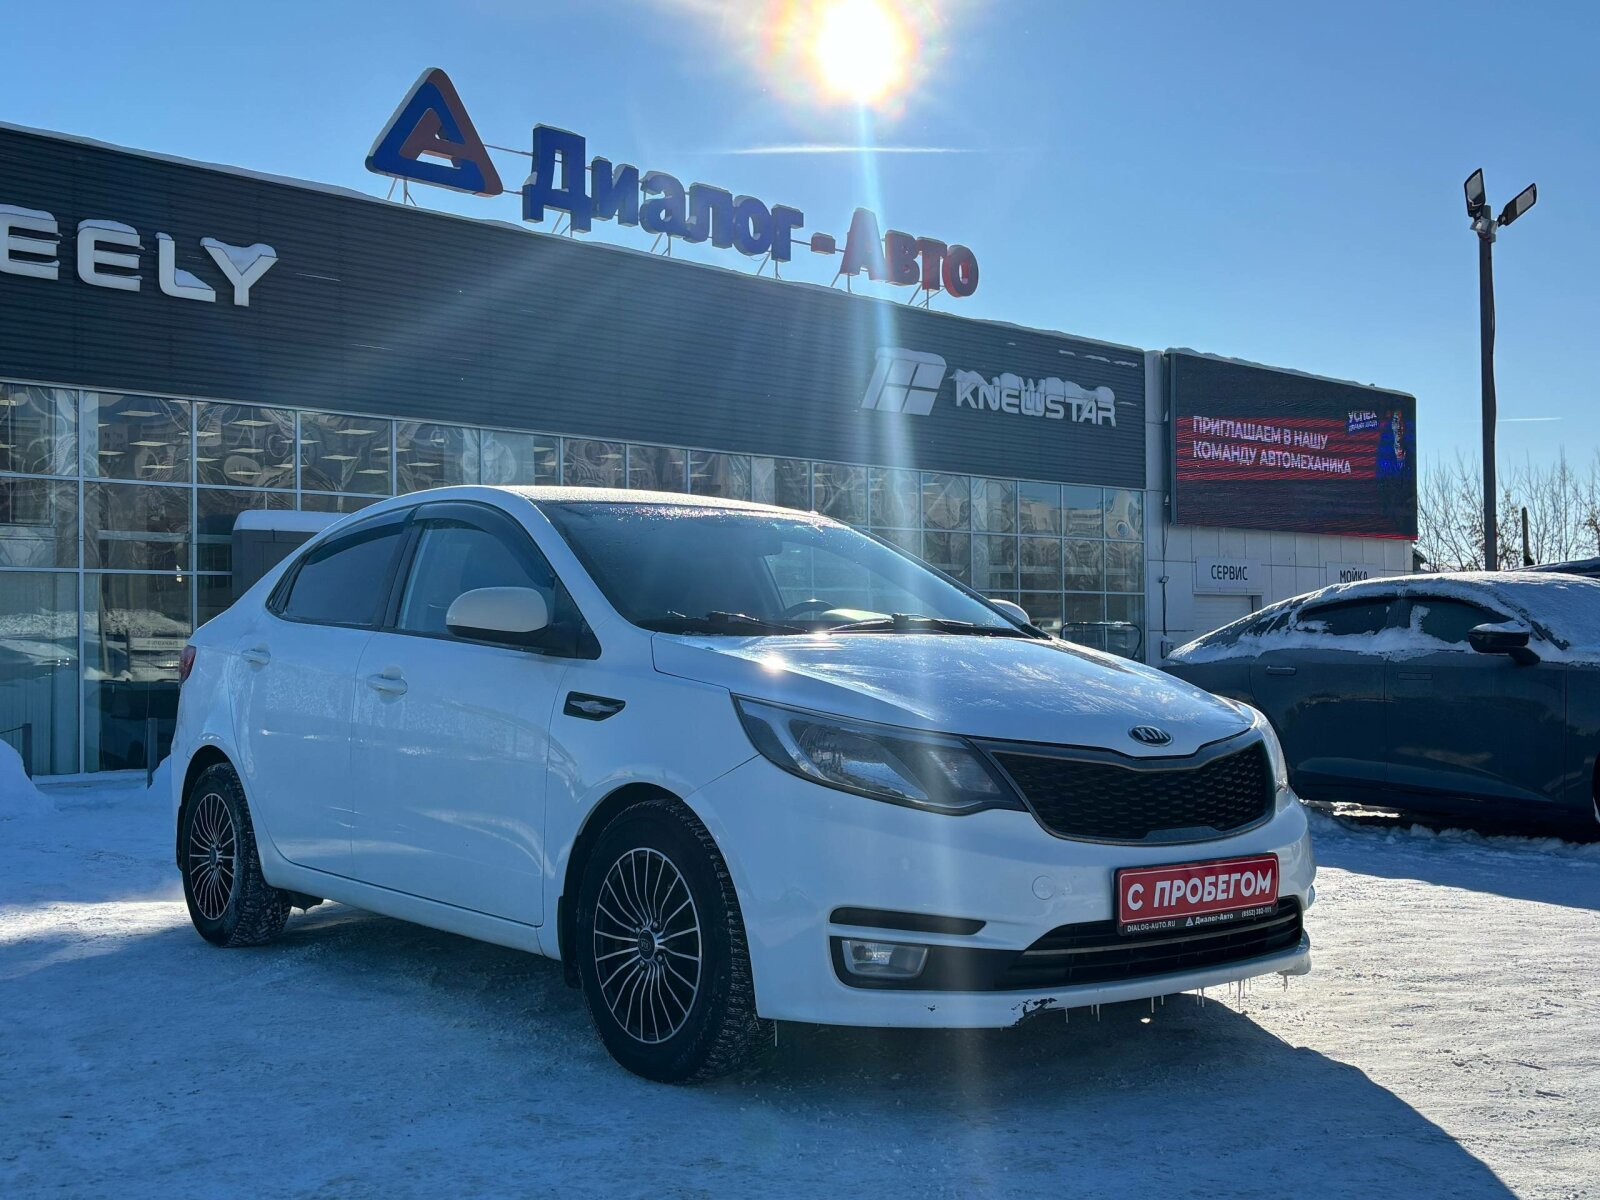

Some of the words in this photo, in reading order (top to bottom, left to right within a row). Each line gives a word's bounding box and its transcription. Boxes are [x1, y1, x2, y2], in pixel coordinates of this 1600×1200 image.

[954, 371, 1117, 427] KNEWSTAR
[1193, 415, 1281, 444] ПРИГЛАШАЕМ
[1283, 429, 1292, 445] В
[1294, 430, 1328, 450] НАШУ
[1193, 440, 1257, 466] КОМАНДУ
[1259, 449, 1352, 474] АВТОМЕХАНИКА
[1211, 564, 1248, 581] СЕРВИС
[1127, 883, 1144, 911] С
[1153, 868, 1272, 908] ПРОБЕГОМ
[1127, 920, 1176, 932] DIALOG-AUTO.RU
[1195, 913, 1234, 925] Диалог-Авто
